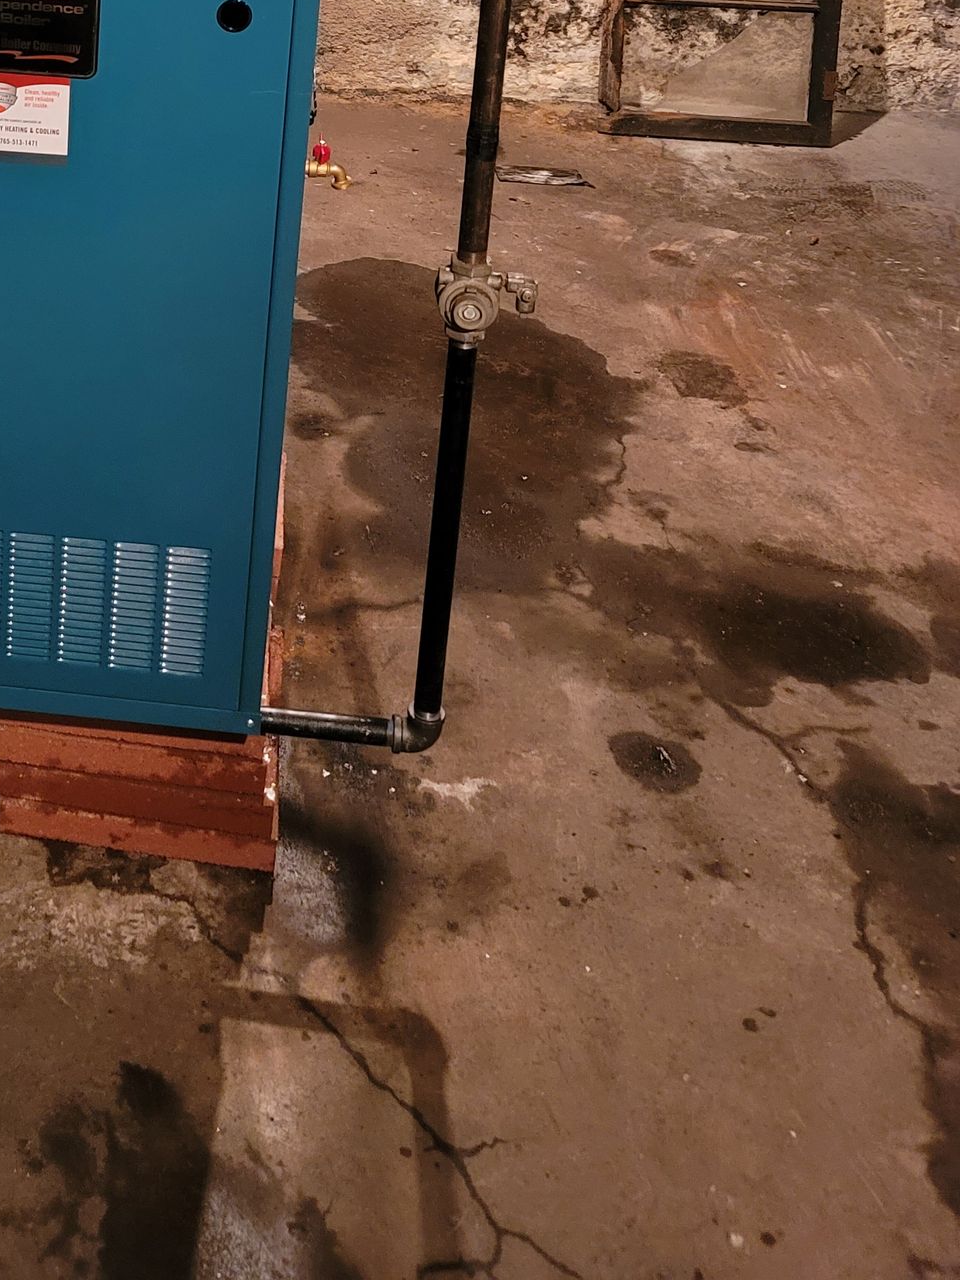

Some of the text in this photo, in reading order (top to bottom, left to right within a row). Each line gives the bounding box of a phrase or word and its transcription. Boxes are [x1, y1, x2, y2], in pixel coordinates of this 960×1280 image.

[0, 12, 51, 26] Boiler
[4, 125, 28, 133] HEATING
[35, 127, 60, 135] COOLING
